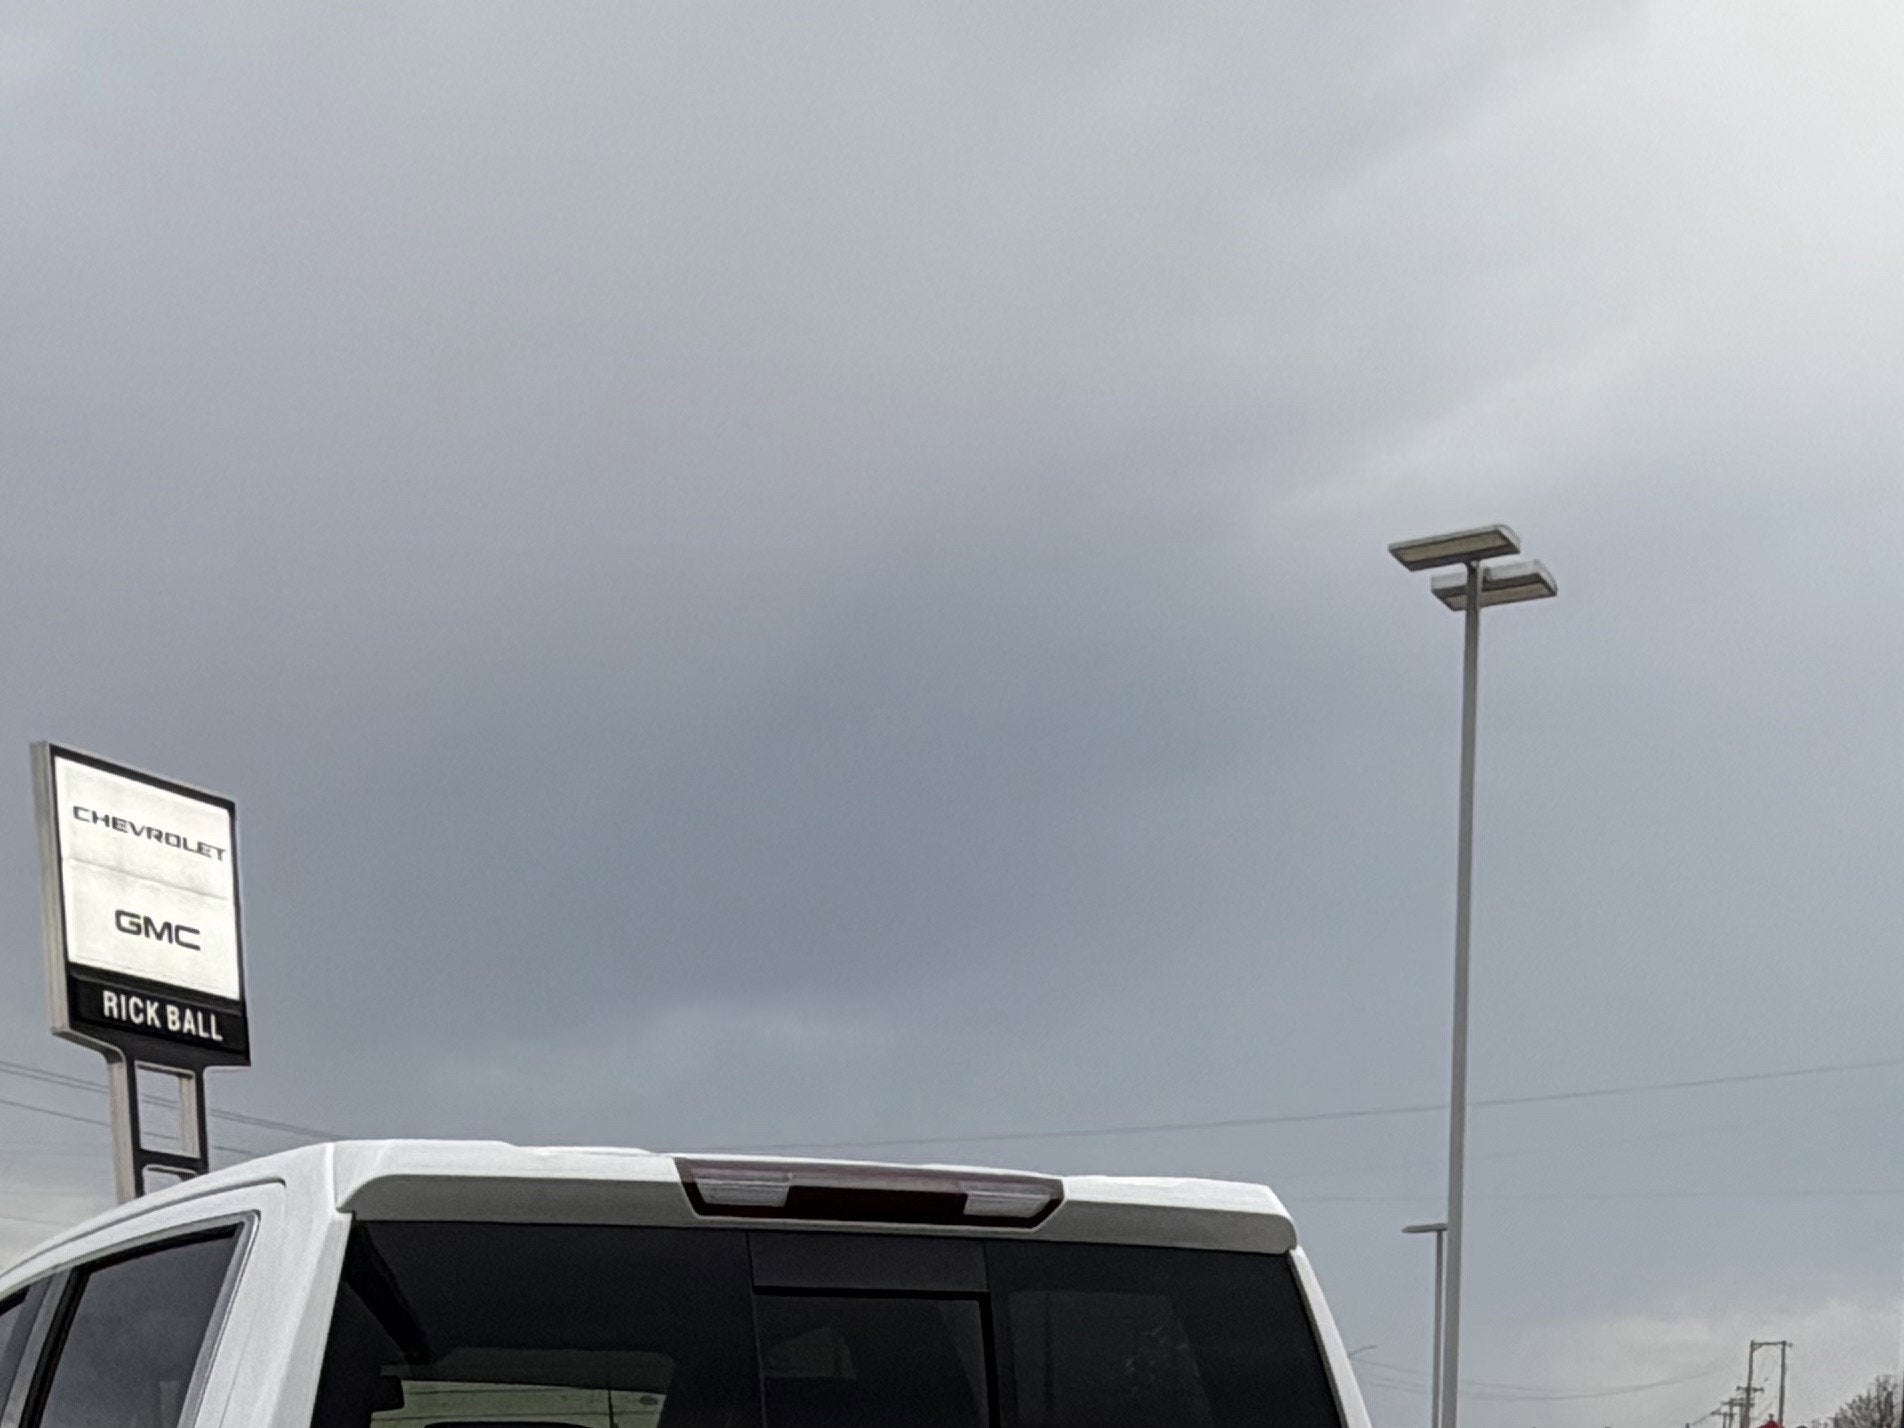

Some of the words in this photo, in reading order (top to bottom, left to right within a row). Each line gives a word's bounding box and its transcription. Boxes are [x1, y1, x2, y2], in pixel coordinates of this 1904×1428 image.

[72, 805, 226, 862] CHEVROLET
[114, 909, 201, 951] GMC
[102, 990, 161, 1028] RICK
[166, 1003, 224, 1042] BALL
